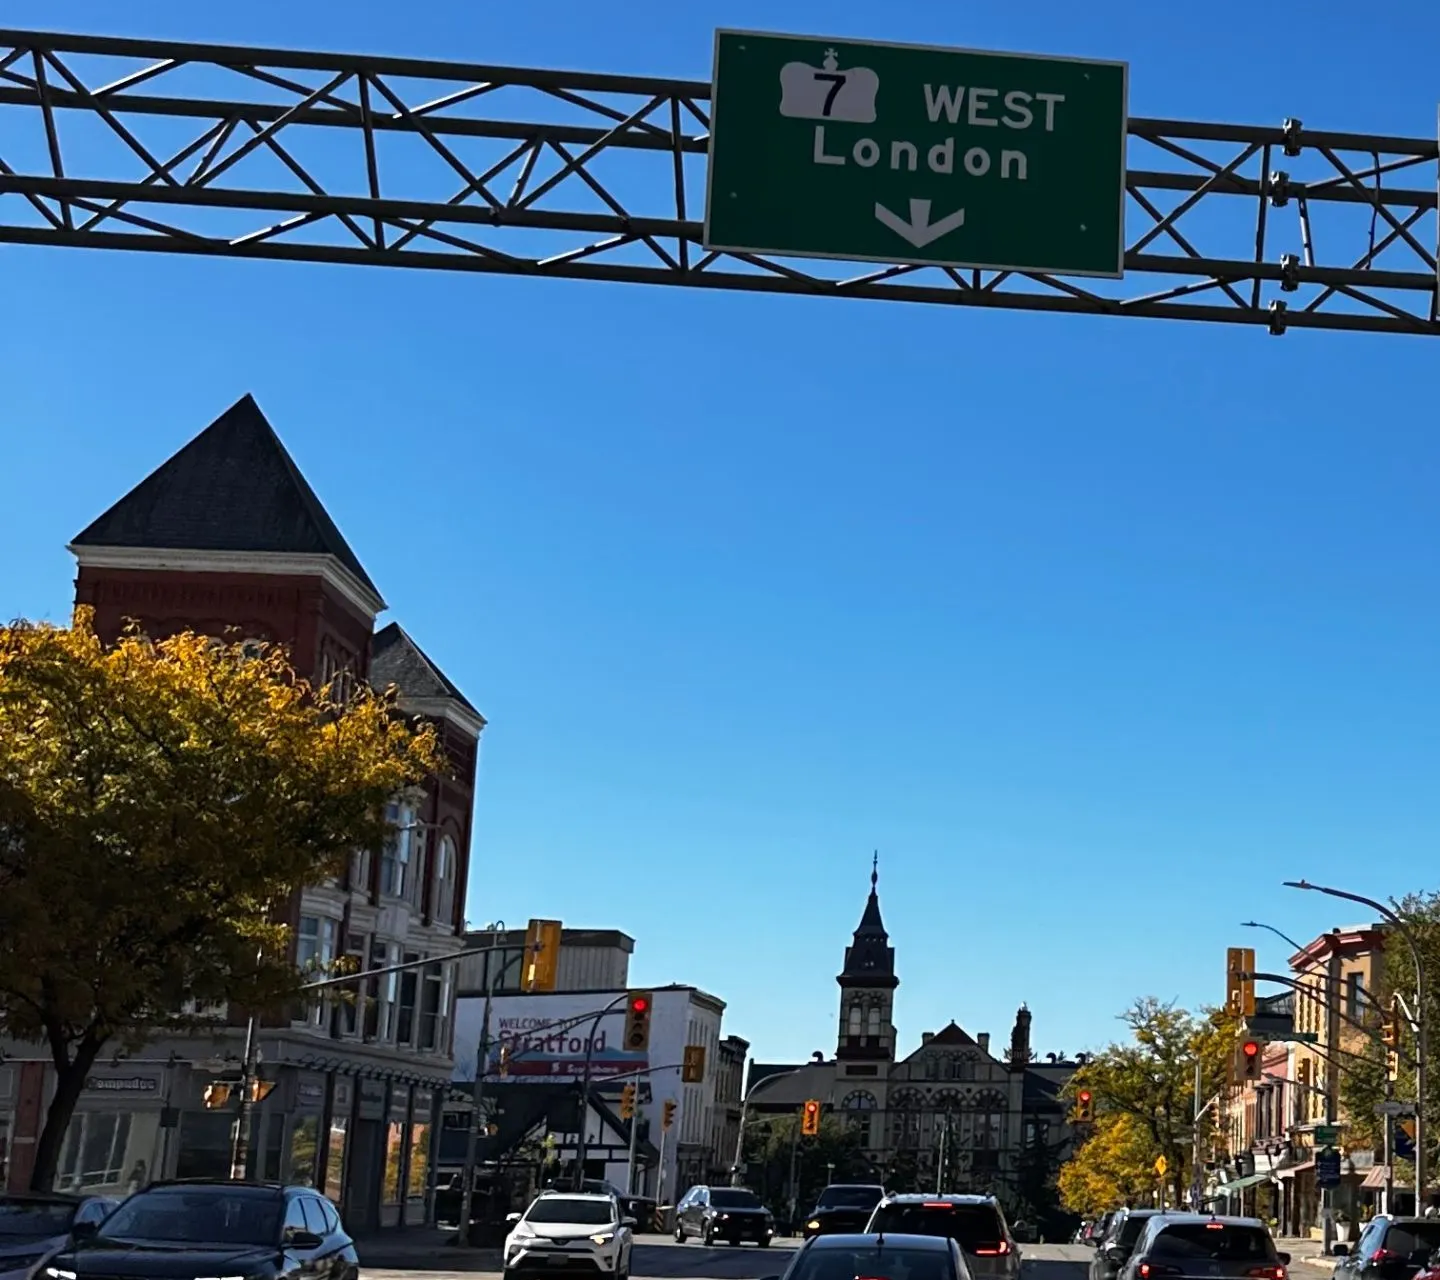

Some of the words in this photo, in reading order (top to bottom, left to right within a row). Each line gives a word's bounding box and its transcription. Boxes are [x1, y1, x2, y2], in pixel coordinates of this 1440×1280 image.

[813, 72, 847, 117] 7
[923, 82, 1066, 131] WEST
[813, 125, 1028, 180] London
[499, 1018, 551, 1030] WELCOME
[499, 1030, 606, 1053] Stratford
